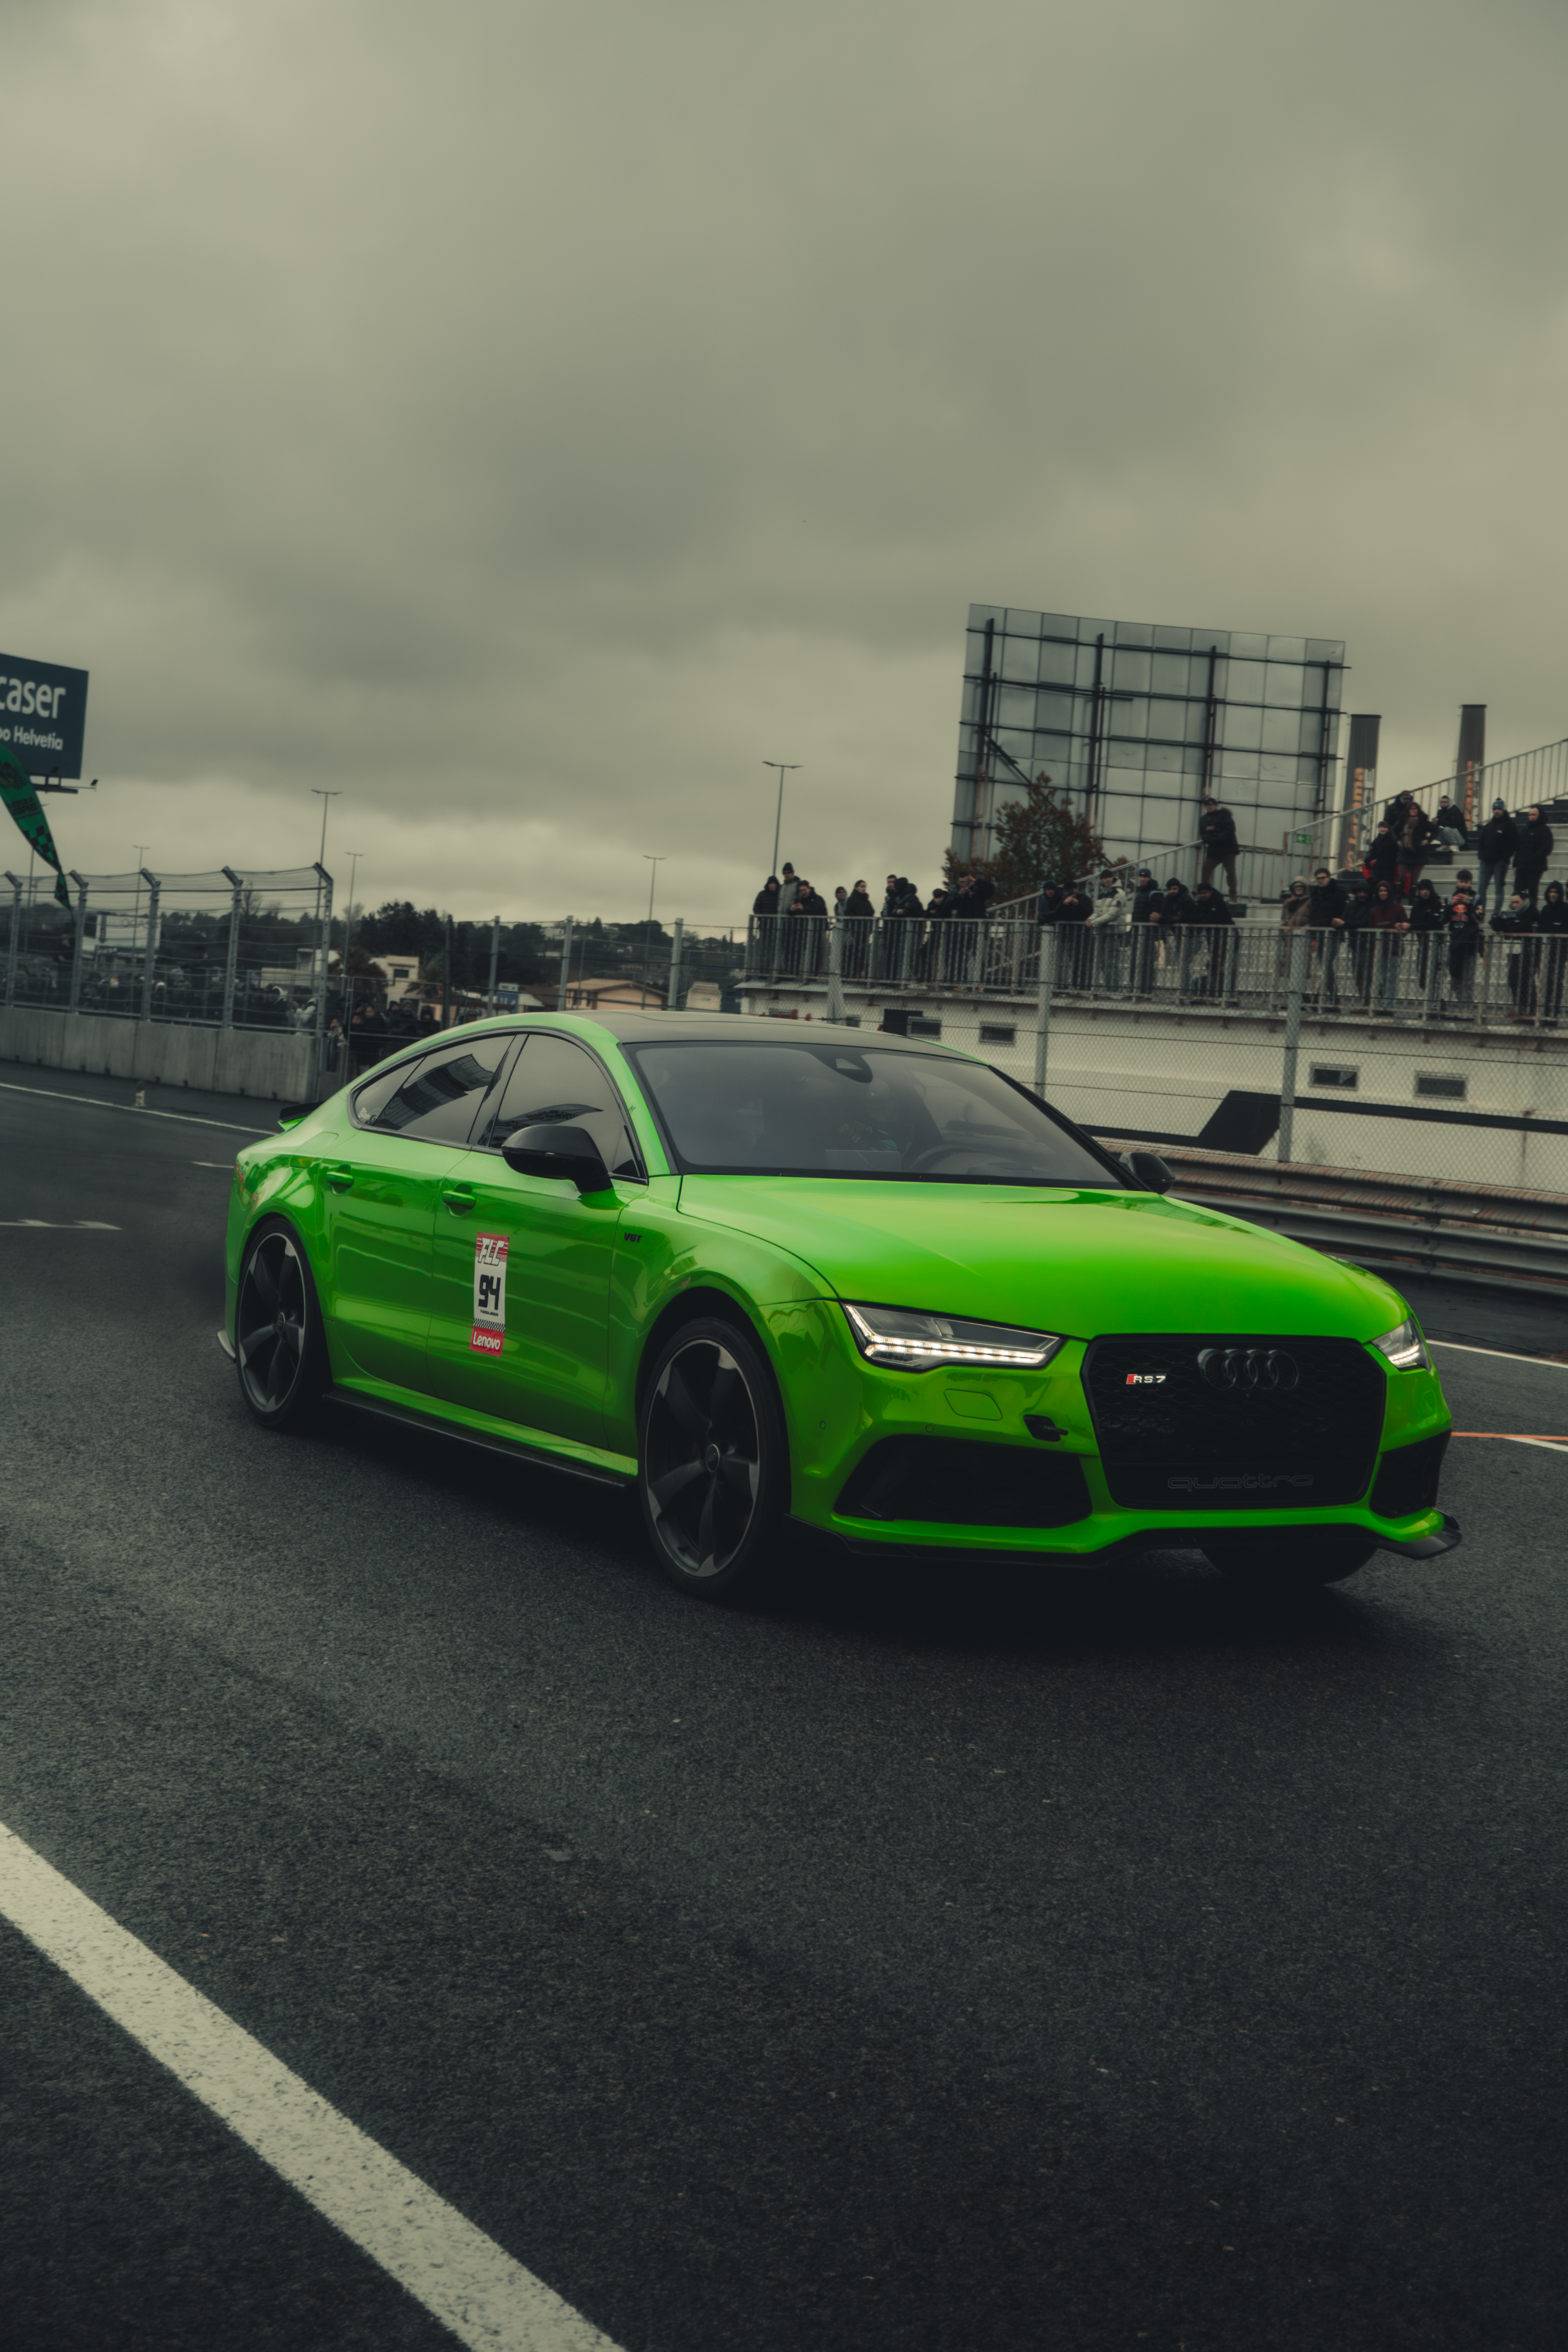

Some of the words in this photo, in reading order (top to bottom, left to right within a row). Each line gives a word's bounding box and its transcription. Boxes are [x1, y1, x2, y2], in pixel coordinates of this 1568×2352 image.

[14, 725, 63, 750] Helvetia
[477, 1238, 505, 1266] FLC
[478, 1274, 501, 1310] 94
[473, 1332, 501, 1350] Lenovo
[1168, 1474, 1313, 1492] quattro
